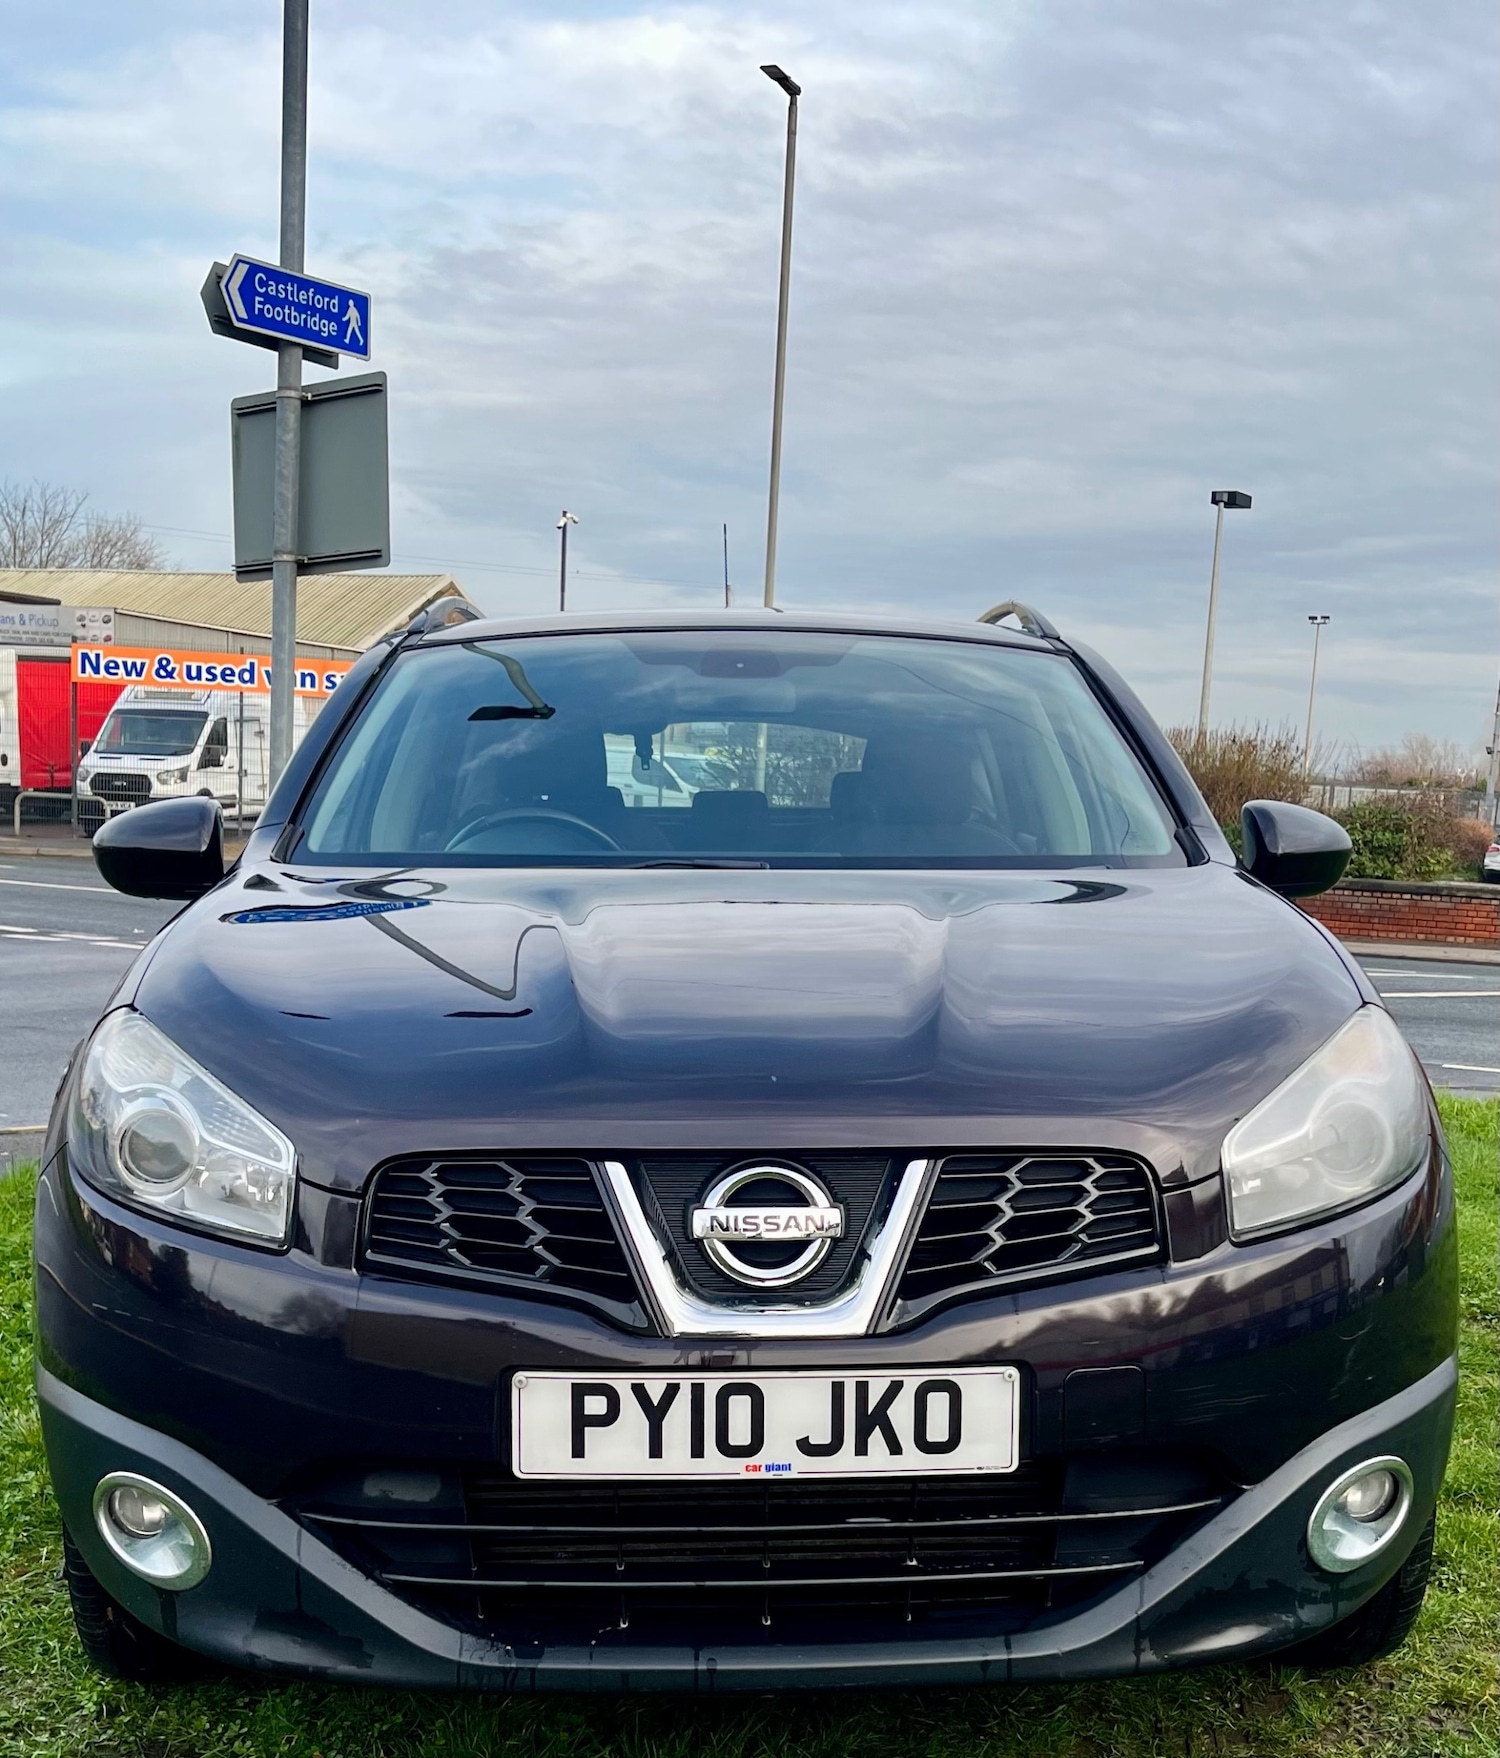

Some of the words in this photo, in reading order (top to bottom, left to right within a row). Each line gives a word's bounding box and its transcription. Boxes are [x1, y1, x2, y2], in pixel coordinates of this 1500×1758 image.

[254, 272, 339, 313] Castleford
[254, 296, 338, 337] Footbridge
[0, 614, 16, 625] ans
[19, 613, 26, 626] &
[28, 613, 59, 630] Pickup
[80, 652, 145, 677] New
[155, 656, 176, 679] &
[185, 661, 255, 685] used
[264, 669, 316, 689] vn
[710, 1214, 825, 1233] NISSAN
[570, 1381, 765, 1459] PY10
[795, 1379, 962, 1458] JKO
[745, 1464, 763, 1472] car
[765, 1462, 792, 1472] giant
